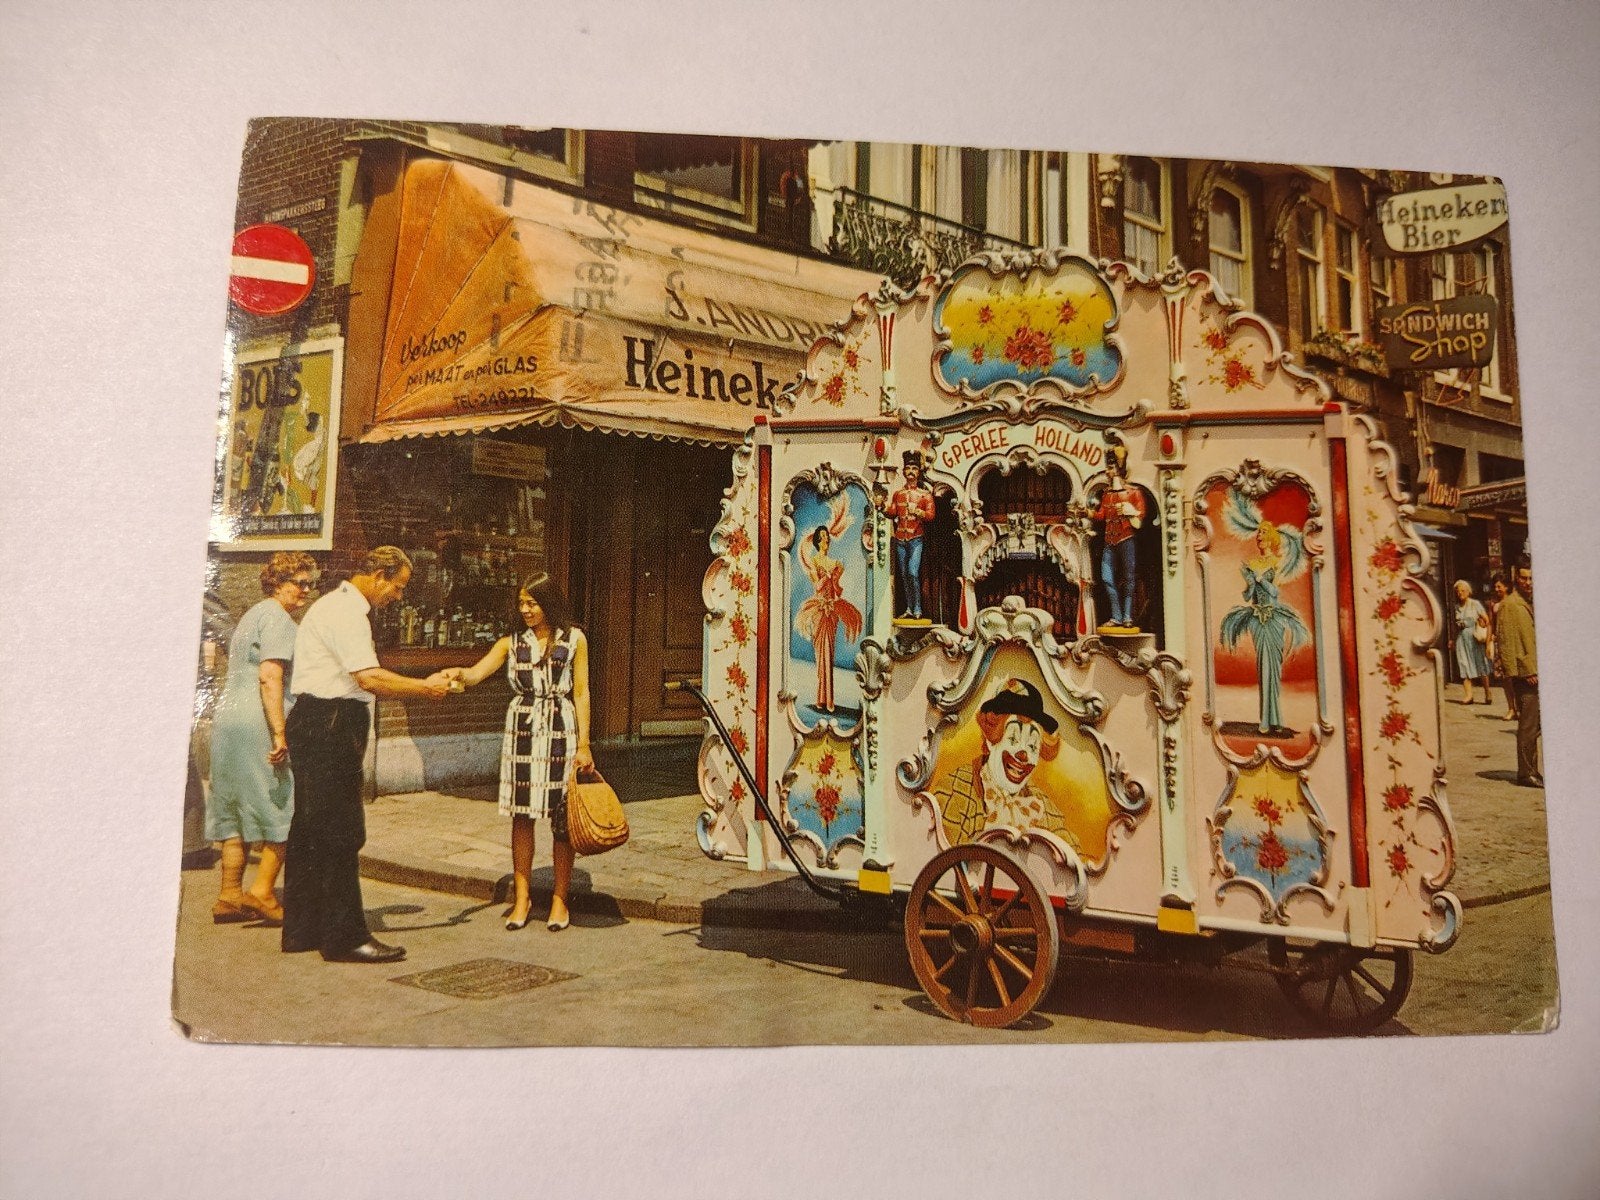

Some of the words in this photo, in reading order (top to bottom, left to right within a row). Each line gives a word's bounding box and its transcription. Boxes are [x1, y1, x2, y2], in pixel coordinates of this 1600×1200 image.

[1376, 193, 1507, 225] Heineken
[1402, 224, 1462, 249] Bier
[1379, 311, 1490, 335] SANDWICH
[1400, 303, 1488, 363] Shop
[493, 355, 538, 377] GLAS
[239, 361, 303, 411] BOLS
[1034, 425, 1102, 467] HOLLAND
